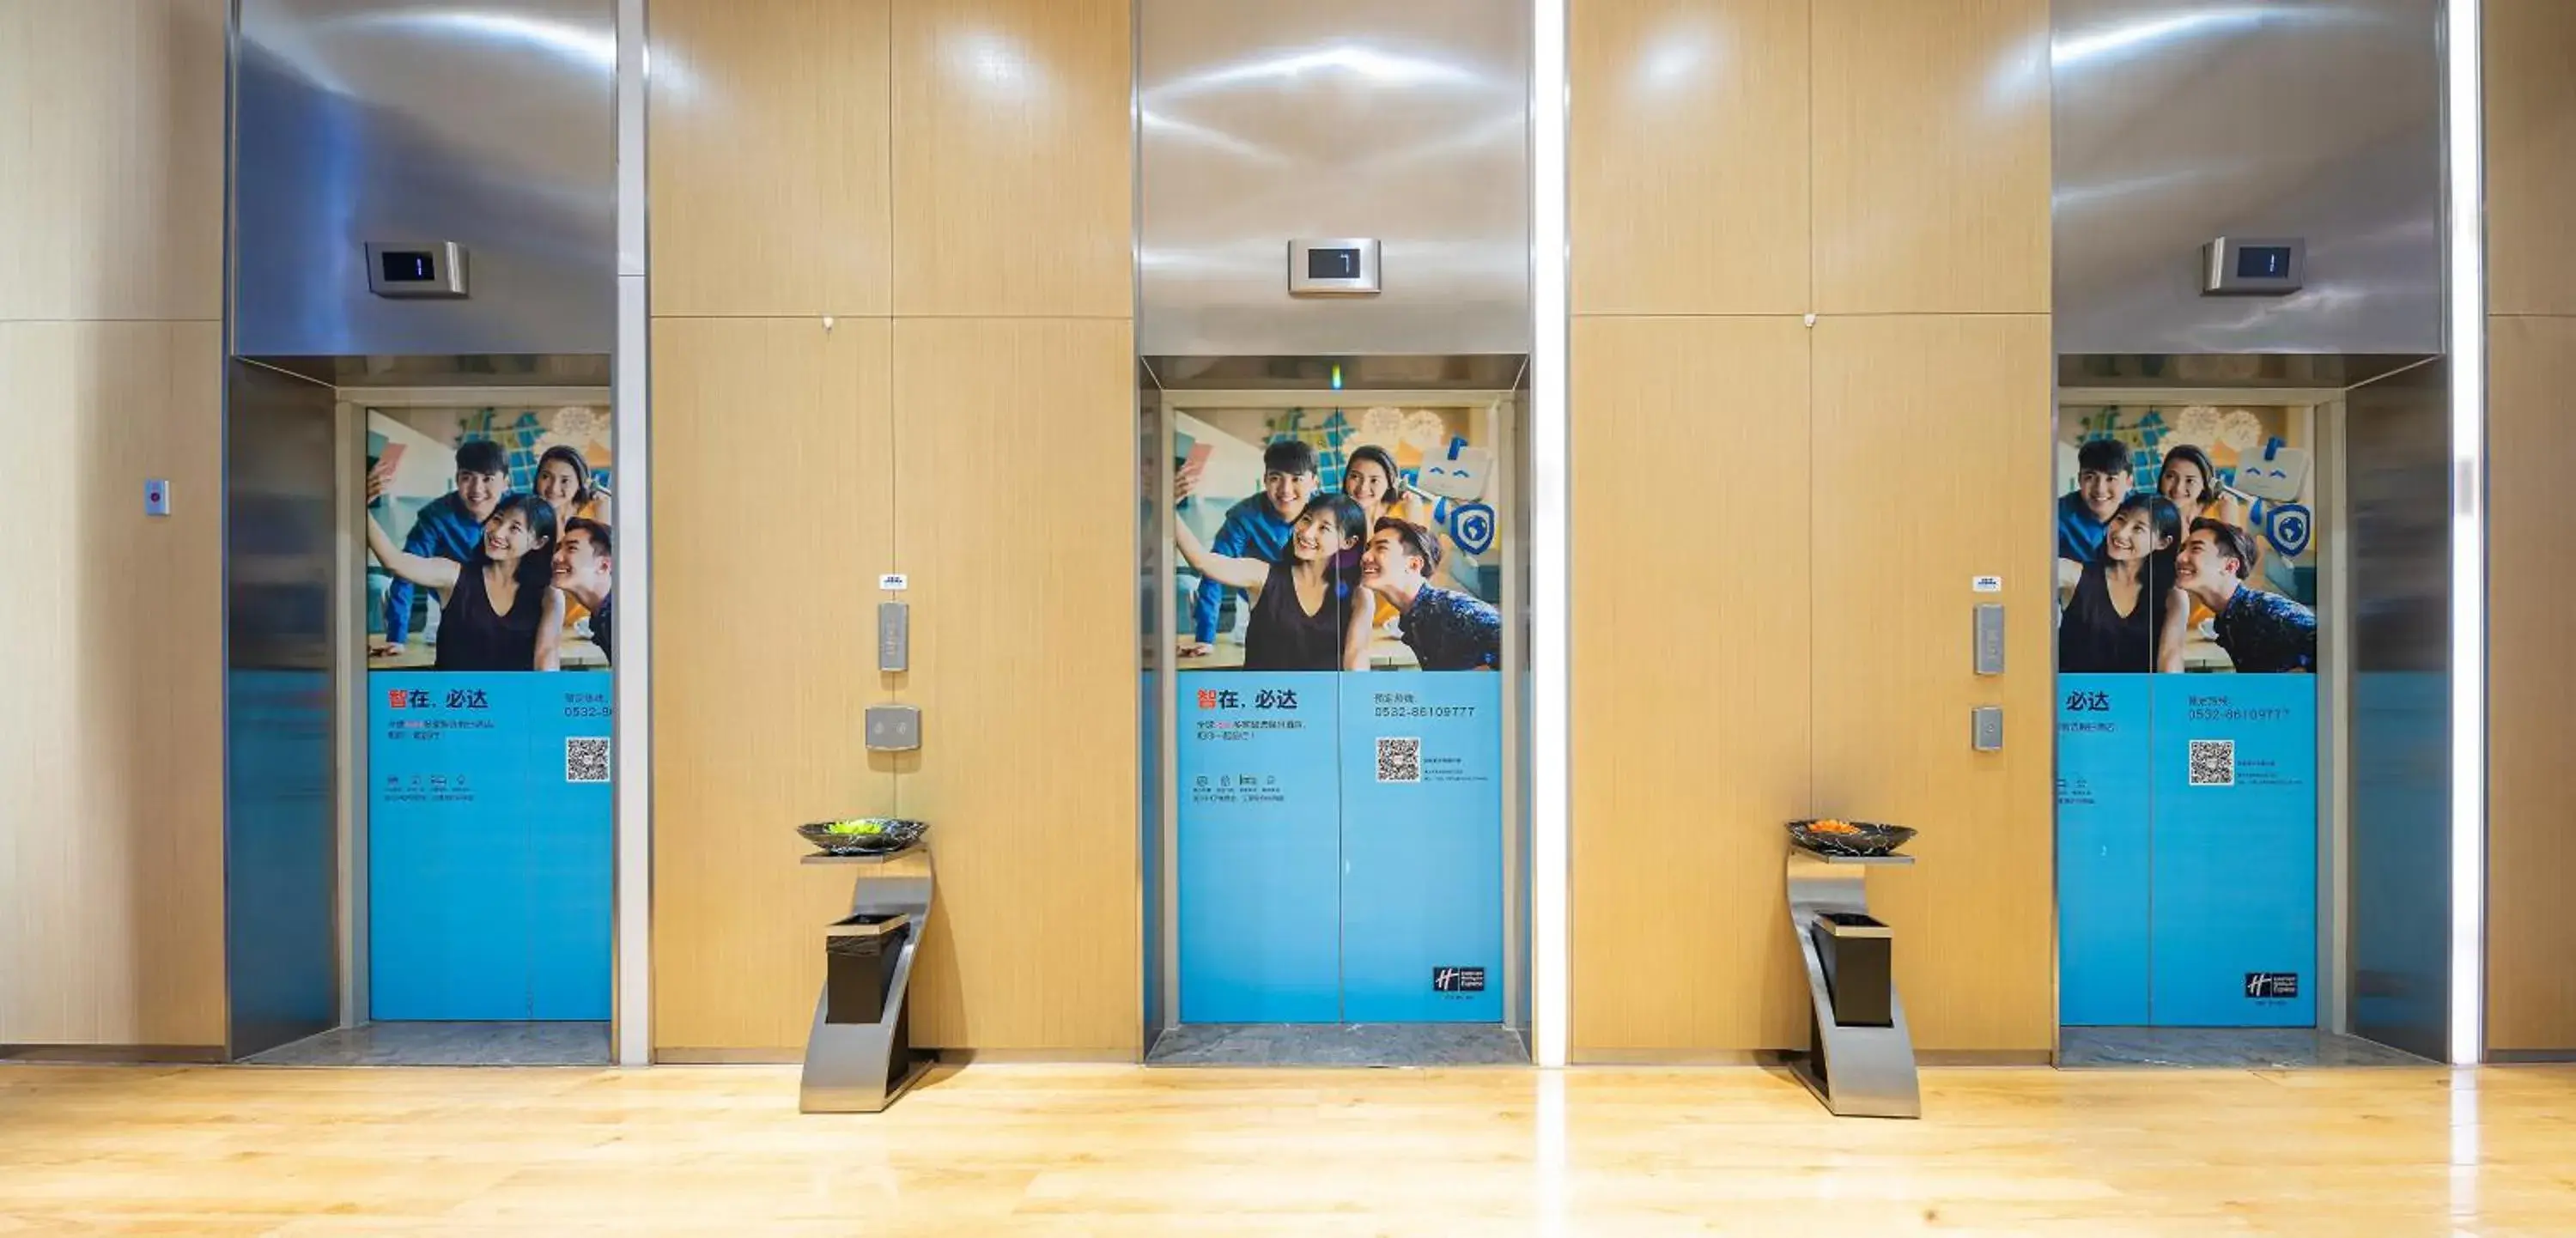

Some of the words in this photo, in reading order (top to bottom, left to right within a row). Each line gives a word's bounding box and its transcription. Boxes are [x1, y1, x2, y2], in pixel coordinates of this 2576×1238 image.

[416, 258, 422, 276] 1
[1340, 253, 1351, 274] 7
[2269, 253, 2275, 273] 1
[1374, 707, 1476, 718] 0532-86109777
